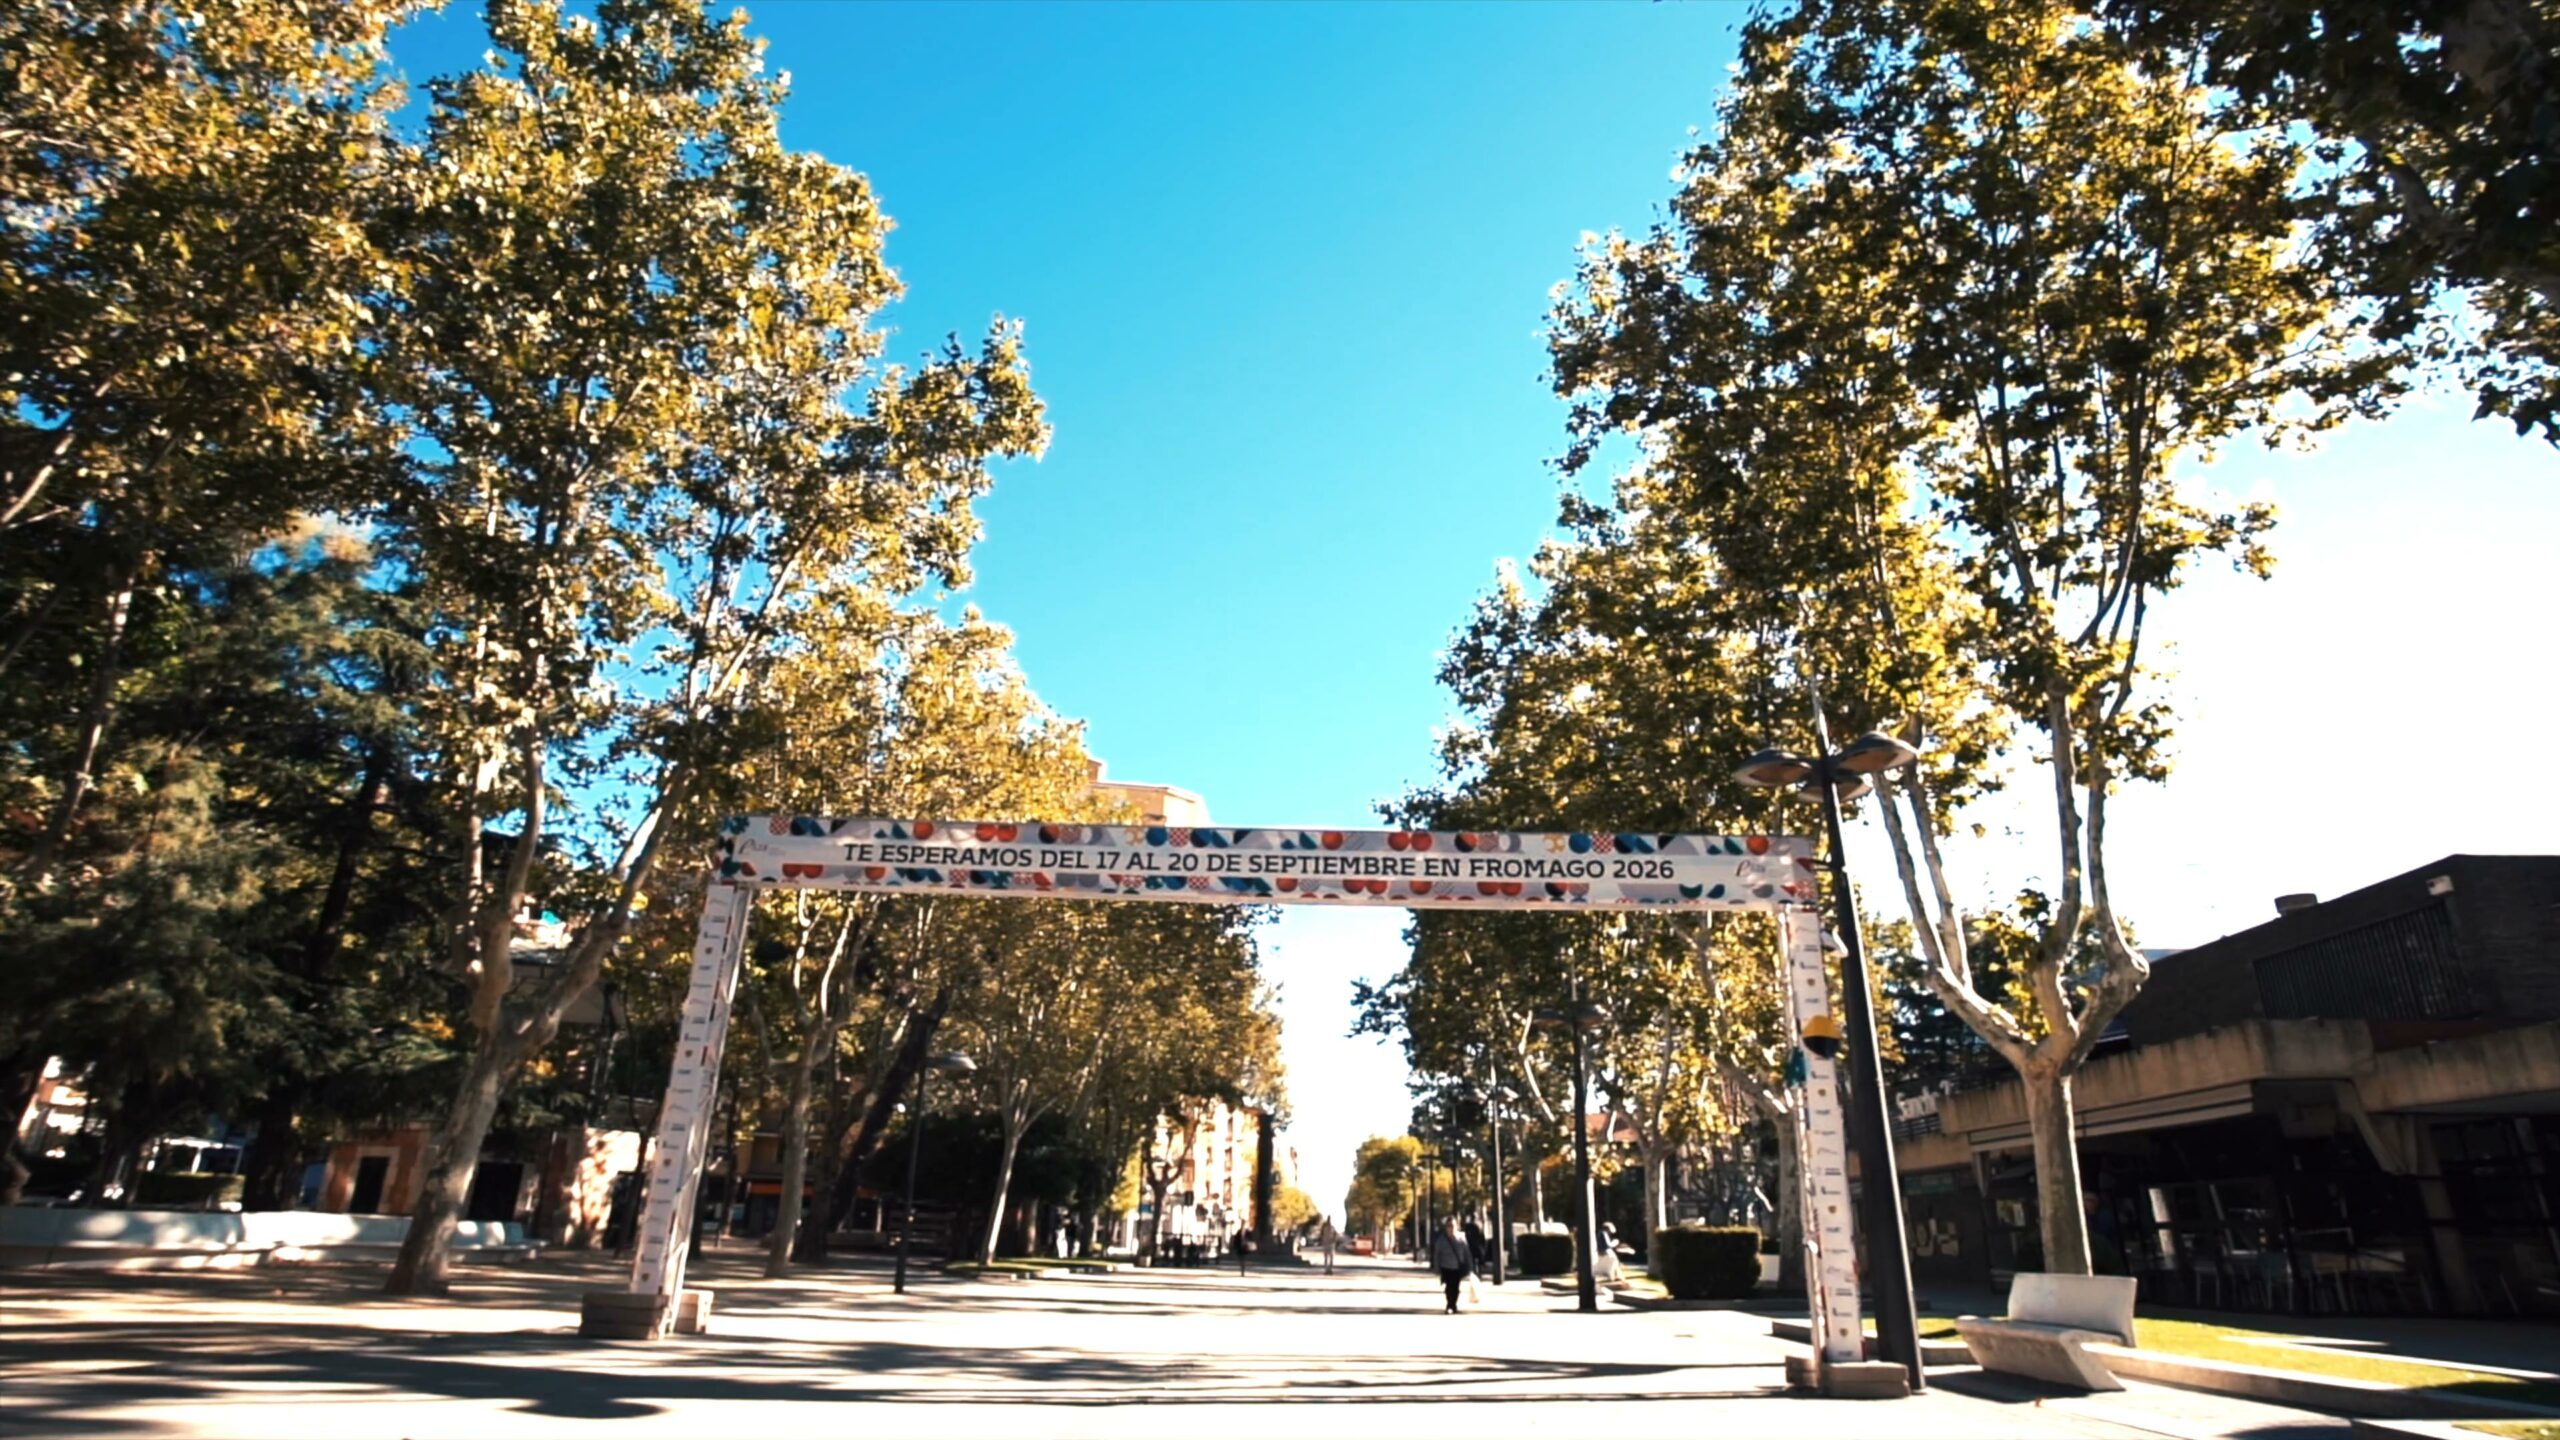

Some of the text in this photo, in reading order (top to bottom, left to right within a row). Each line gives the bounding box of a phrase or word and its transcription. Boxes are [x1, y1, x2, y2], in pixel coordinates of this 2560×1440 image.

[843, 843, 1674, 879] TE ESPERAMOS DEL 17 AL 20 DE SEPTIEMBRE EN FROMAGO 2026
